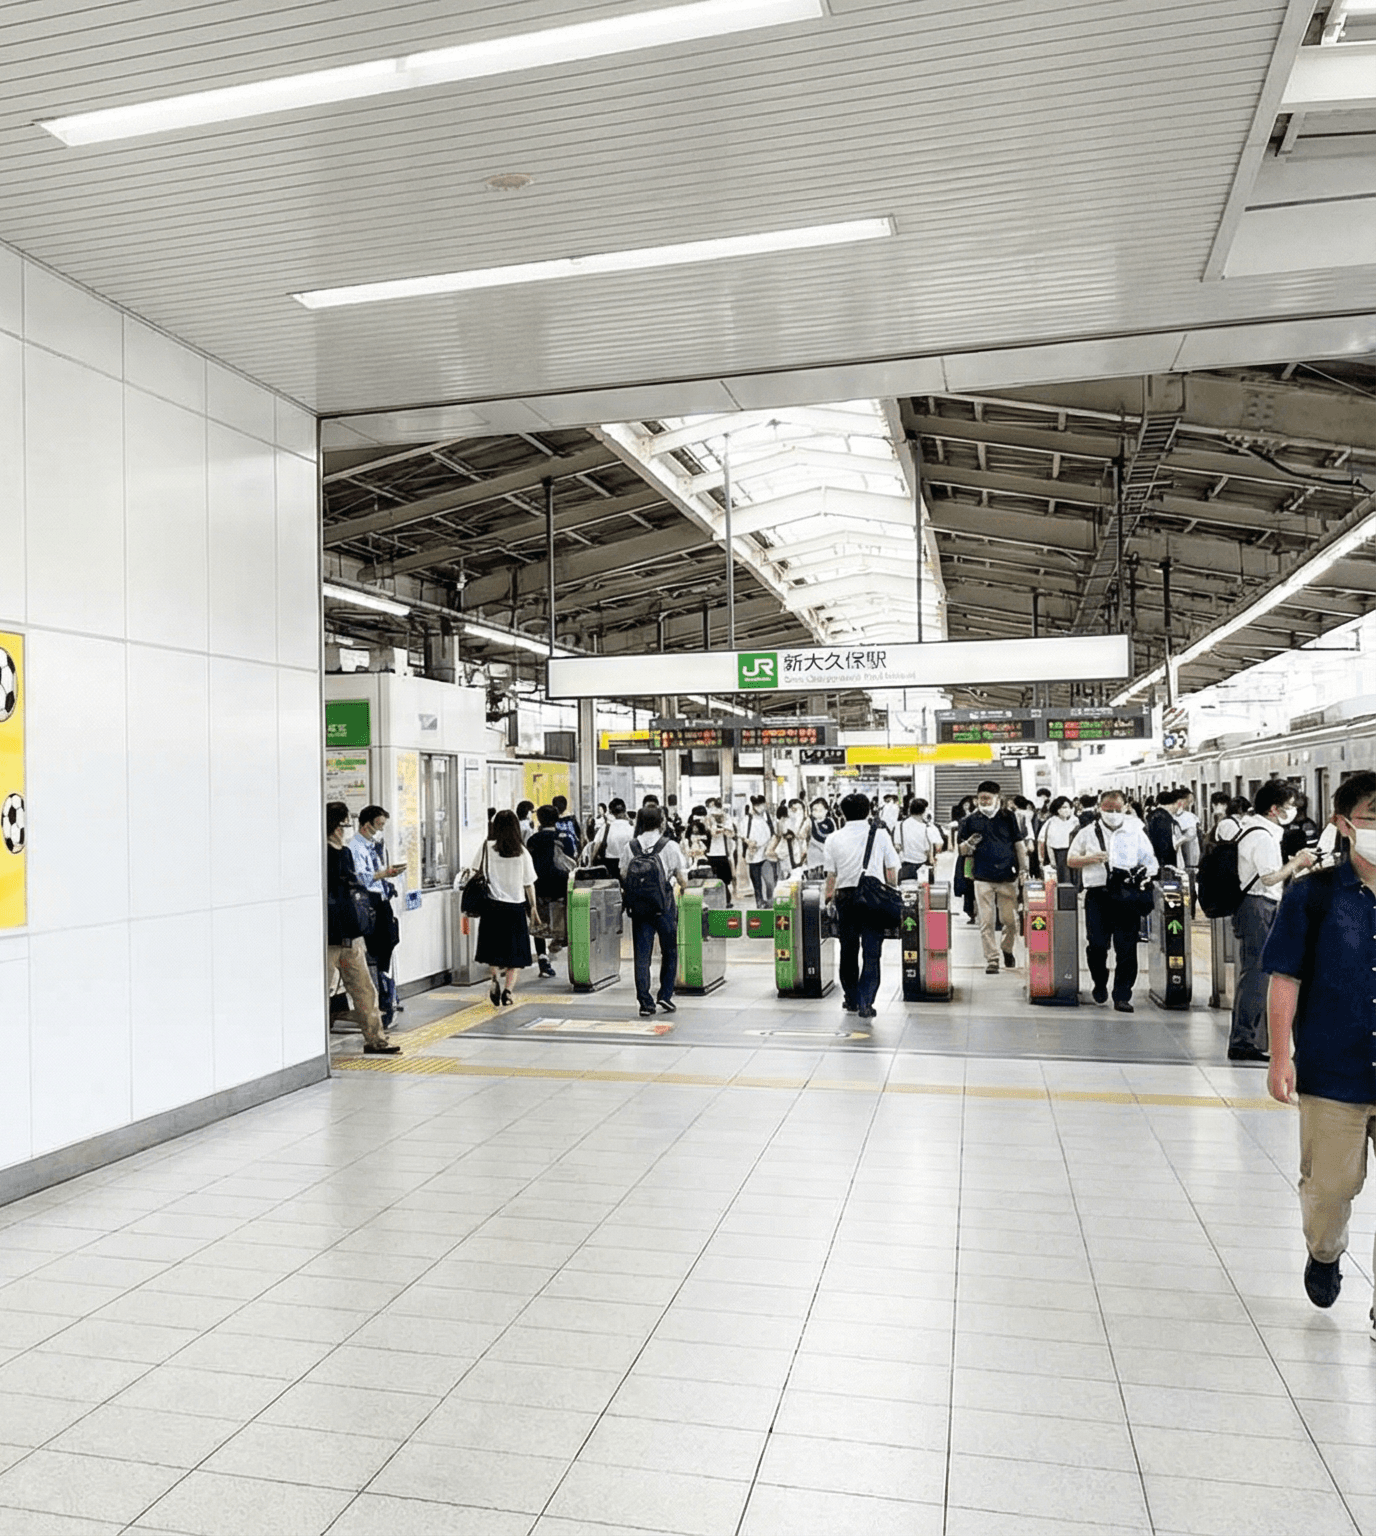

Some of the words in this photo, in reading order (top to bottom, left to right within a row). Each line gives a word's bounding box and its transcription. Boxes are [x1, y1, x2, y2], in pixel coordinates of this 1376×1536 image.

[742, 658, 775, 676] JR
[783, 651, 887, 672] 新大久保駅
